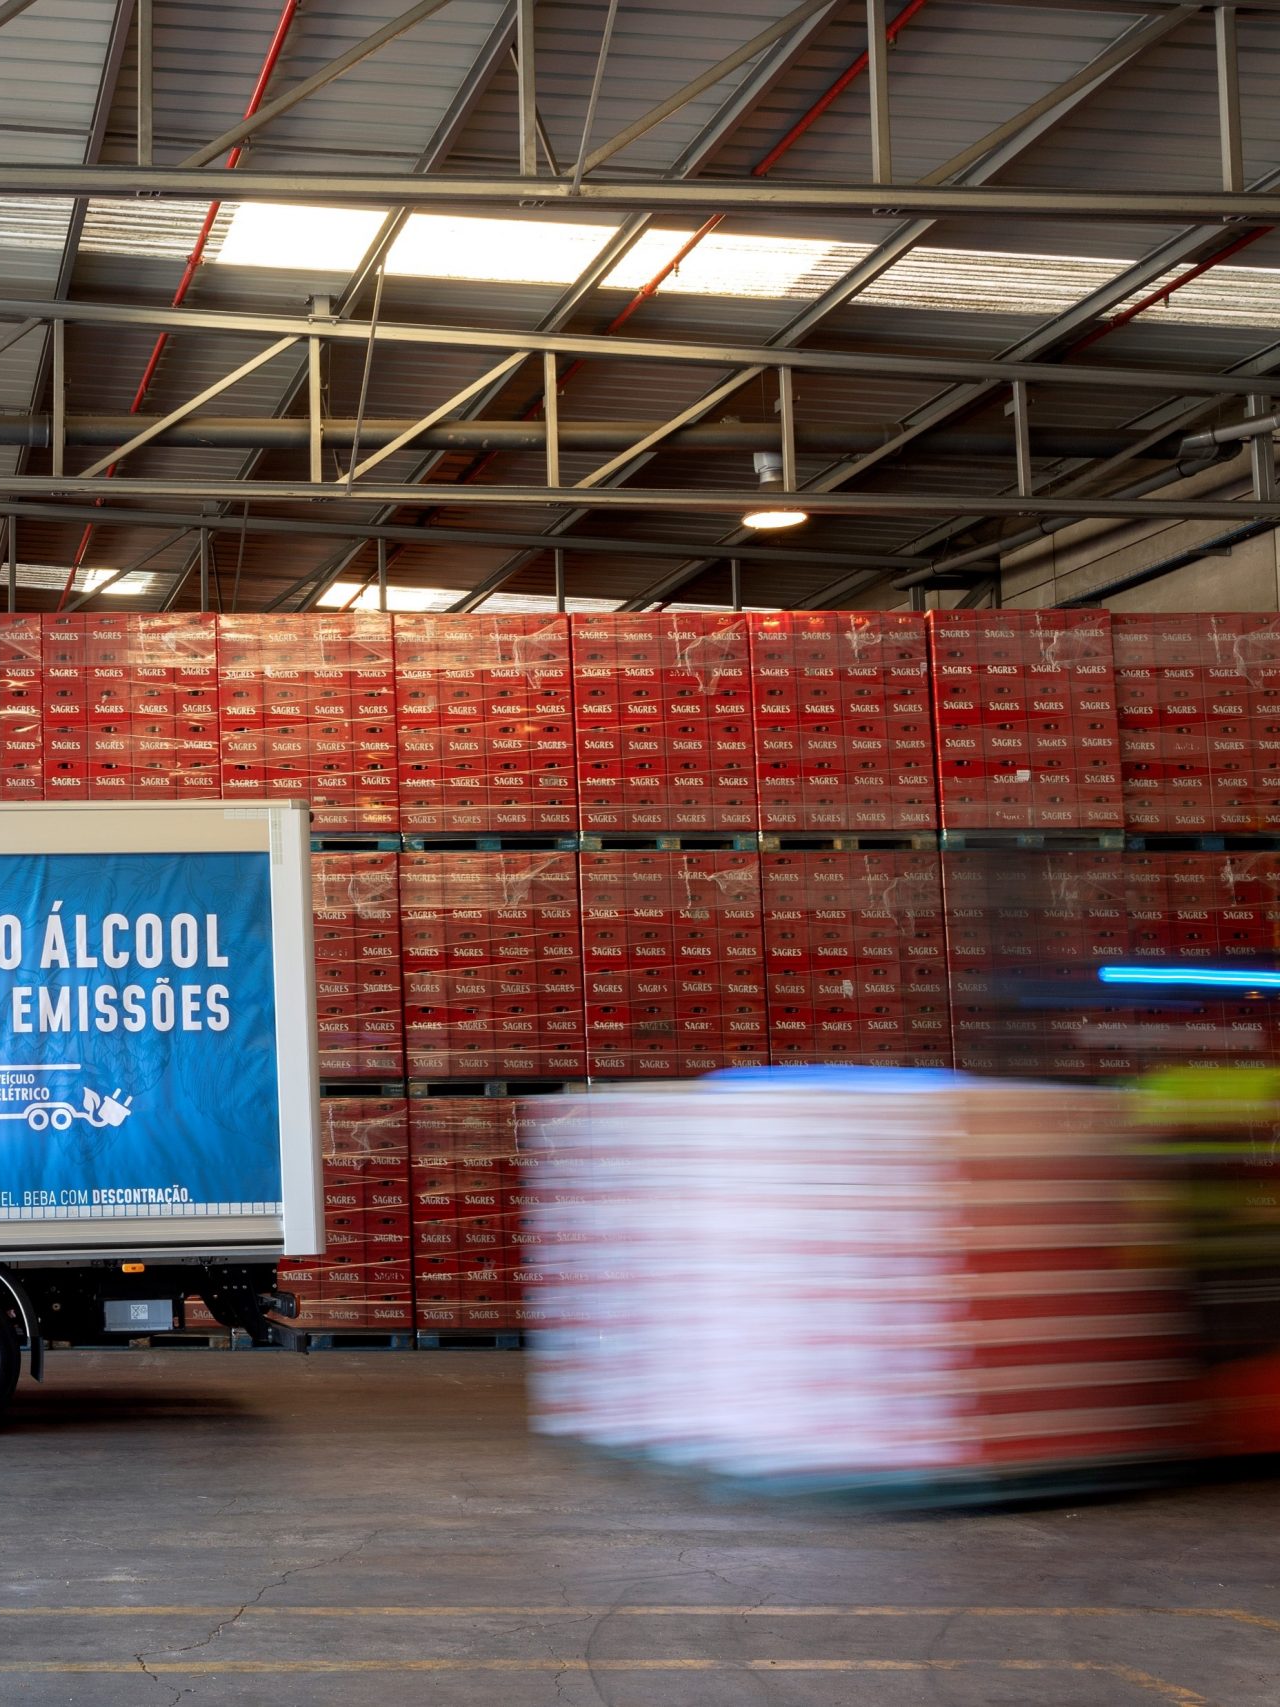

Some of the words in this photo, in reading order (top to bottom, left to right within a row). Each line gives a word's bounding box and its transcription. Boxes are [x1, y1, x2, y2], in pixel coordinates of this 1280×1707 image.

[49, 631, 79, 641] SAGRES
[5, 667, 35, 677] SAGRES
[49, 668, 79, 677] SAGRES
[942, 665, 972, 675] SAGRES
[1164, 668, 1194, 678] SAGRES
[50, 704, 80, 714] SAGRES
[271, 705, 300, 715] SAGRES
[314, 705, 344, 715] SAGRES
[358, 705, 388, 714] SAGRES
[491, 704, 521, 714] SAGRES
[582, 704, 612, 713] SAGRES
[671, 704, 700, 714] SAGRES
[715, 704, 745, 713] SAGRES
[761, 704, 790, 713] SAGRES
[805, 704, 835, 713] SAGRES
[893, 703, 923, 713] SAGRES
[943, 700, 973, 710] SAGRES
[1034, 701, 1063, 710] SAGRES
[1080, 700, 1110, 710] SAGRES
[1167, 704, 1197, 714] SAGRES
[1213, 704, 1242, 714] SAGRES
[6, 740, 36, 750] SAGRES
[51, 740, 81, 750] SAGRES
[228, 741, 257, 751] SAGRES
[272, 742, 301, 751] SAGRES
[360, 741, 389, 751] SAGRES
[449, 741, 479, 751] SAGRES
[584, 740, 614, 749] SAGRES
[628, 741, 658, 750] SAGRES
[673, 740, 702, 750] SAGRES
[763, 740, 793, 750] SAGRES
[808, 740, 837, 749] SAGRES
[852, 740, 882, 749] SAGRES
[895, 739, 925, 749] SAGRES
[992, 738, 1021, 747] SAGRES
[1081, 737, 1113, 747] SAGRES
[51, 777, 81, 786] SAGRES
[184, 776, 213, 786] SAGRES
[674, 776, 704, 786] SAGRES
[718, 776, 748, 786] SAGRES
[898, 775, 928, 784] SAGRES
[1218, 777, 1247, 787] SAGRES
[318, 814, 348, 824] SAGRES
[452, 814, 481, 824] SAGRES
[497, 813, 526, 823] SAGRES
[540, 813, 570, 823] SAGRES
[1174, 873, 1205, 883] SAGRES
[1222, 910, 1254, 920] SAGRES
[40, 900, 229, 969] ÁLCOOL
[362, 946, 392, 956] SAGRES
[454, 947, 483, 957] SAGRES
[499, 946, 528, 956] SAGRES
[543, 946, 573, 955] SAGRES
[636, 946, 665, 956] SAGRES
[681, 946, 711, 956] SAGRES
[727, 946, 756, 956] SAGRES
[863, 946, 892, 956] SAGRES
[907, 945, 939, 956] SAGRES
[1134, 946, 1166, 956] SAGRES
[1179, 947, 1211, 957] SAGRES
[1225, 945, 1256, 956] SAGRES
[410, 983, 440, 993] SAGRES
[456, 984, 485, 994] SAGRES
[593, 983, 622, 993] SAGRES
[728, 984, 758, 993] SAGRES
[774, 984, 806, 994] SAGRES
[909, 982, 941, 993] SAGRES
[957, 982, 988, 992] SAGRES
[13, 977, 230, 1032] EMISSÕES
[547, 1021, 576, 1030] SAGRES
[730, 1021, 760, 1031] SAGRES
[867, 1020, 899, 1030] SAGRES
[912, 1019, 941, 1029] SAGRES
[959, 1020, 991, 1030] SAGRES
[321, 1059, 351, 1069] SAGRES
[504, 1059, 533, 1068] SAGRES
[548, 1058, 578, 1067] SAGRES
[686, 1059, 716, 1068] SAGRES
[1054, 1058, 1085, 1068] SAGRES
[1099, 1058, 1131, 1068] SAGRES
[24, 1190, 57, 1206] BEBA
[61, 1189, 88, 1205] COM
[92, 1185, 193, 1206] DESCONTRAÇÃO.
[326, 1195, 356, 1204] SAGRES
[372, 1194, 402, 1204] SAGRES
[464, 1195, 496, 1205] SAGRES
[1245, 1195, 1277, 1206] SAGRES
[421, 1233, 451, 1243] SAGRES
[466, 1233, 495, 1243] SAGRES
[373, 1308, 405, 1319] SAGRES
[468, 1309, 500, 1319] SAGRES
